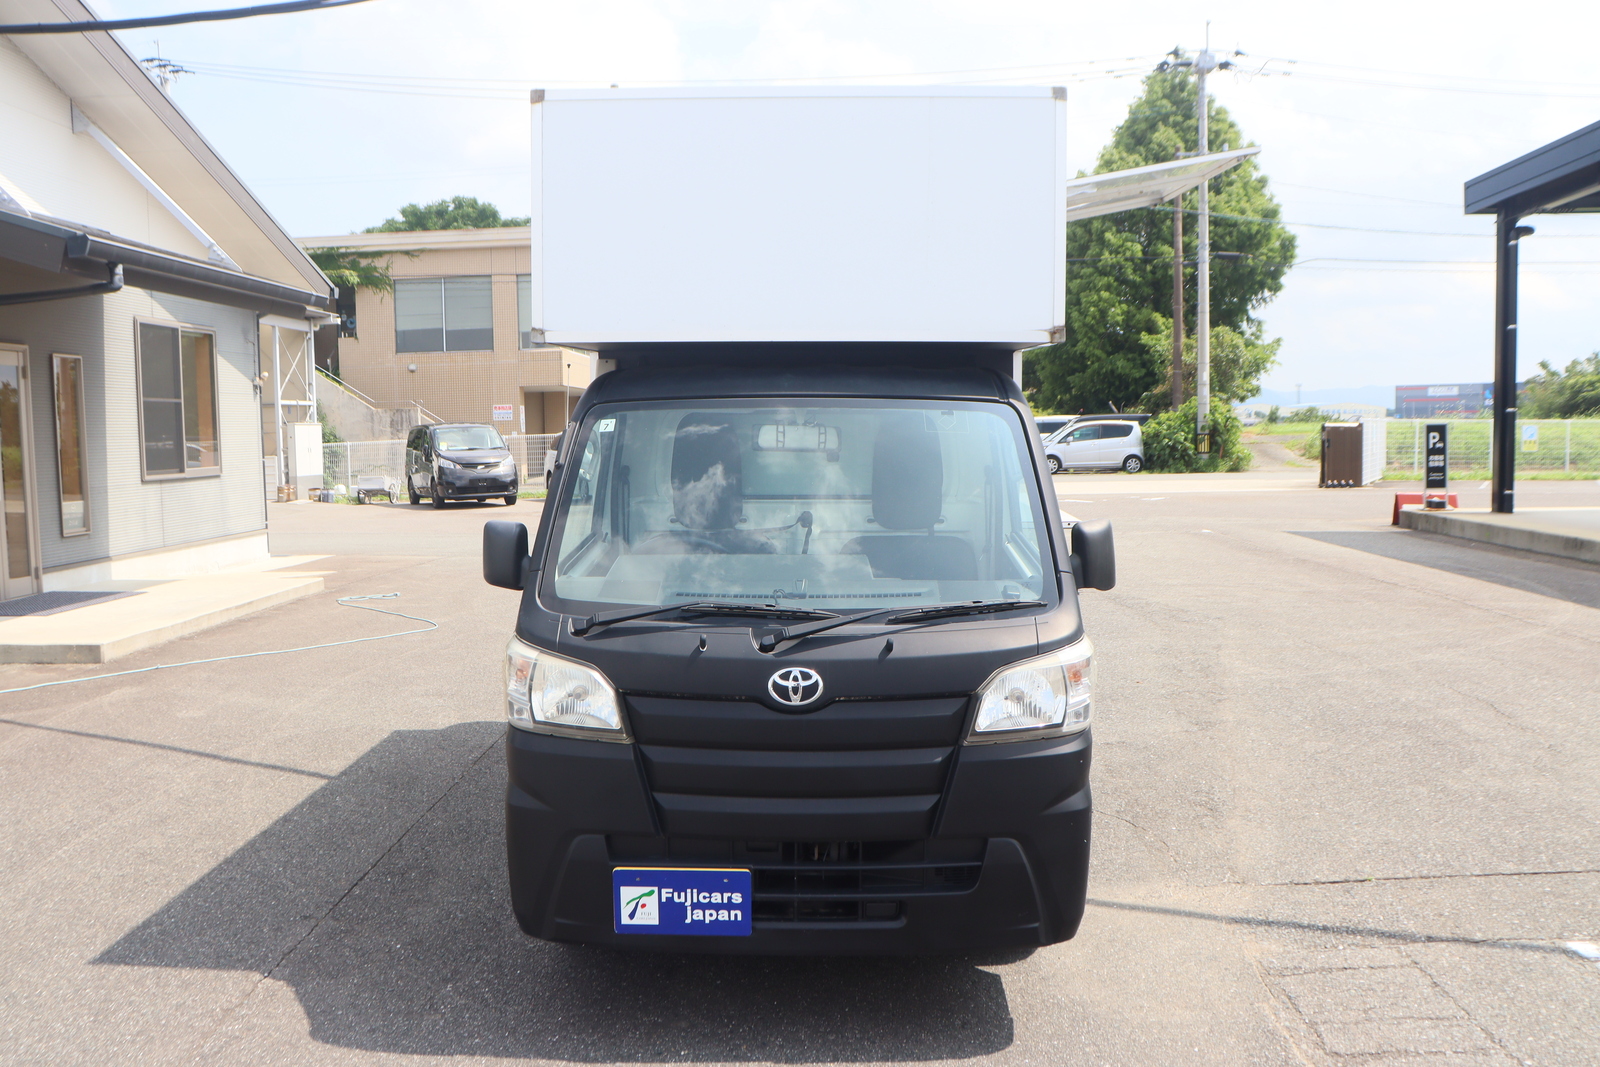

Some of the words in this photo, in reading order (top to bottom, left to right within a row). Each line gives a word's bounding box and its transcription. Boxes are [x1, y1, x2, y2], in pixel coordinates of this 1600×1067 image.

[1428, 431, 1440, 449] P
[661, 888, 743, 906] Fujicars
[685, 906, 742, 924] japan
